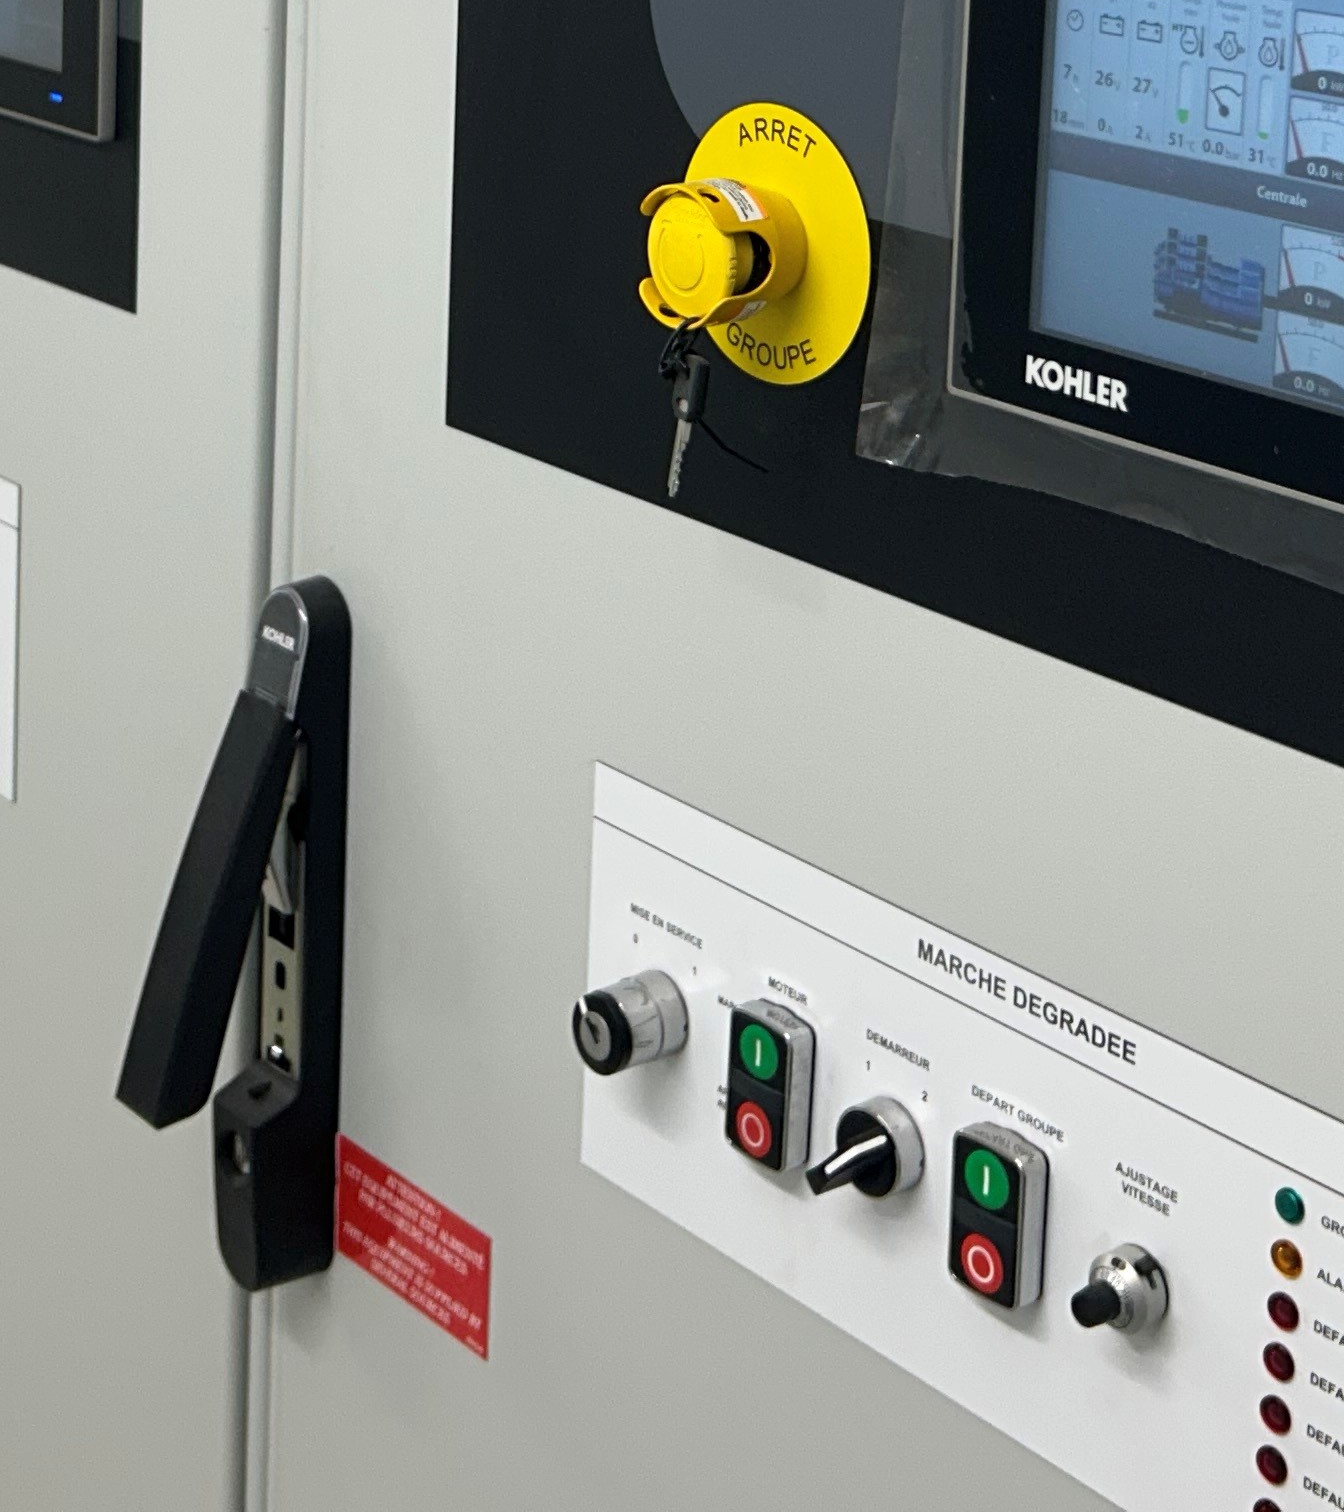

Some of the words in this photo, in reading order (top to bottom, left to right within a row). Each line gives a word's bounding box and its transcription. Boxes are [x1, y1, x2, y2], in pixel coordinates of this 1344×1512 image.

[1063, 63, 1072, 80] 7
[1095, 69, 1114, 88] 26
[1132, 76, 1153, 94] 27
[1317, 76, 1326, 90] 0
[738, 117, 817, 159] ARRET
[1168, 132, 1184, 148] 51
[1202, 138, 1224, 156] 0.0
[1248, 147, 1264, 164] 31
[1306, 161, 1328, 178] 0.0
[1256, 185, 1308, 209] Centrale
[1303, 292, 1314, 307] 0
[725, 321, 817, 371] GROUPE
[1024, 353, 1129, 412] KOHLER
[1293, 376, 1315, 393] 0.0
[630, 901, 650, 922] MISE
[652, 913, 664, 928] EN
[666, 920, 703, 950] SERVICE
[768, 975, 808, 1006] MOTEUR
[917, 937, 1007, 1001] MARCHE
[1012, 985, 1137, 1066] DEGRADEE
[865, 1027, 931, 1072] DEMARREUR
[921, 1090, 929, 1103] 2
[971, 1084, 1016, 1117] DEPART
[1017, 1109, 1065, 1144] GROUPE
[1115, 1161, 1179, 1204] AJUSTAGE
[1121, 1179, 1171, 1217] VITESSE
